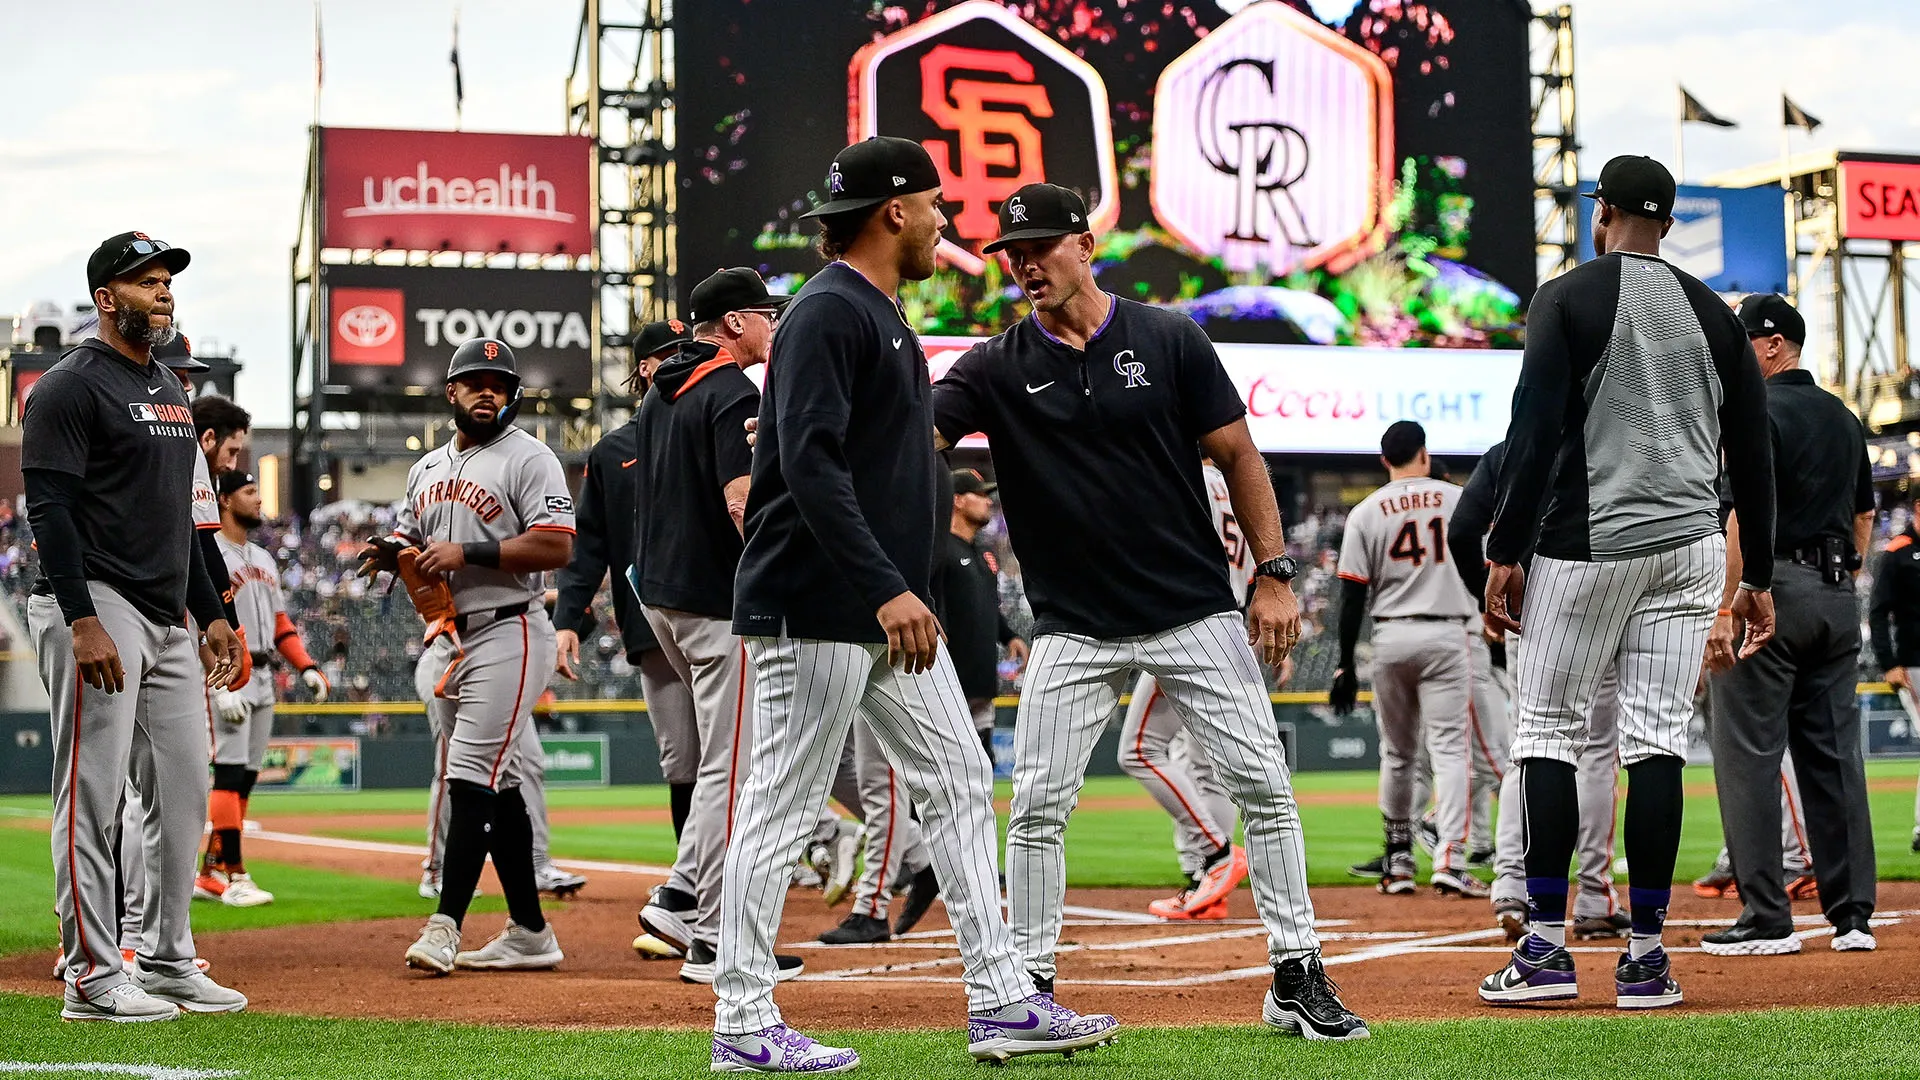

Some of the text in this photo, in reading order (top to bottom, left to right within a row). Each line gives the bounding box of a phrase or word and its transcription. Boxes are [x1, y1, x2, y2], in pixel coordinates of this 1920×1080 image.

[363, 160, 557, 217] uchealth
[1859, 182, 1920, 218] SEA
[415, 308, 590, 348] TOYOTA
[1246, 371, 1484, 422] Coors LIGHT
[148, 424, 194, 439] BASEBALL
[192, 488, 215, 502] IANTS
[428, 479, 504, 525] FRANCISCO
[1380, 491, 1443, 517] FLORES
[1389, 515, 1445, 567] 41
